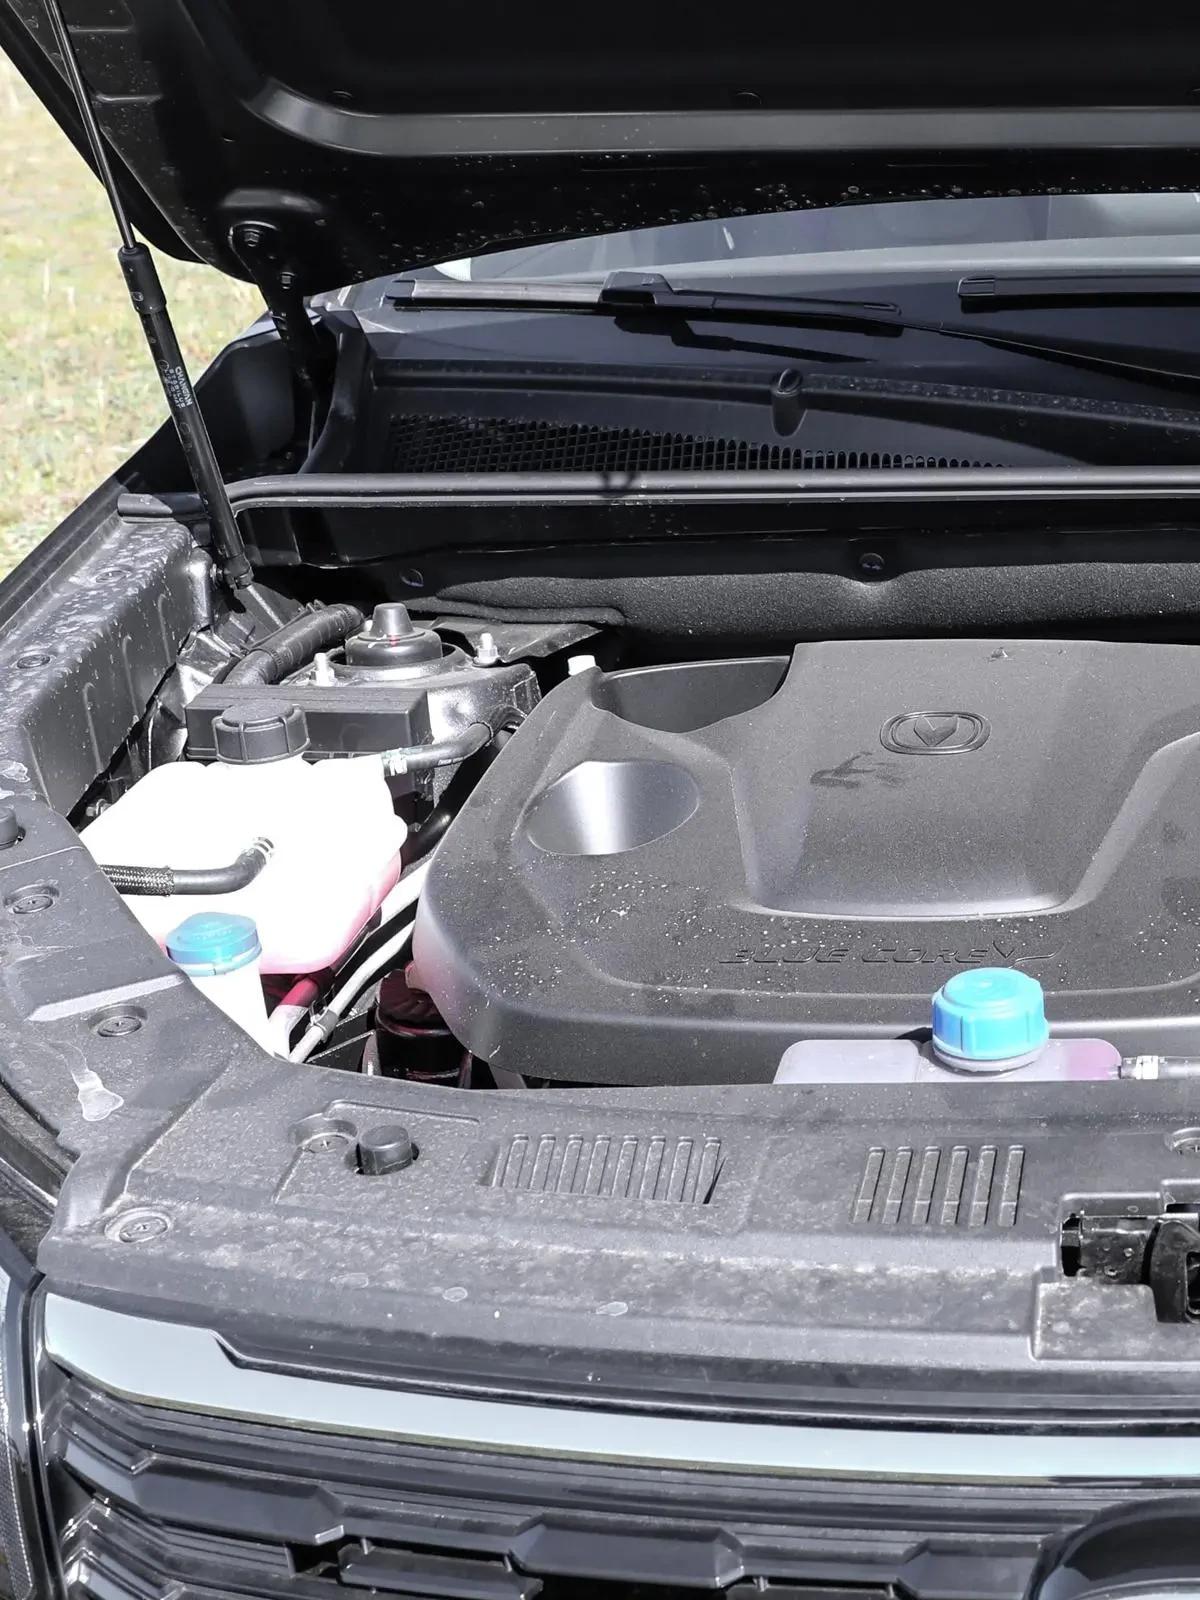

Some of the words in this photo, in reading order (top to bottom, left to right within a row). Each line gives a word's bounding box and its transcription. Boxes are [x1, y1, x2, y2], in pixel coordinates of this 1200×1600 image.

[169, 368, 185, 408] STABILUS
[175, 366, 192, 406] CHANGAN
[718, 948, 851, 965] BLUE
[861, 948, 989, 965] CORE
